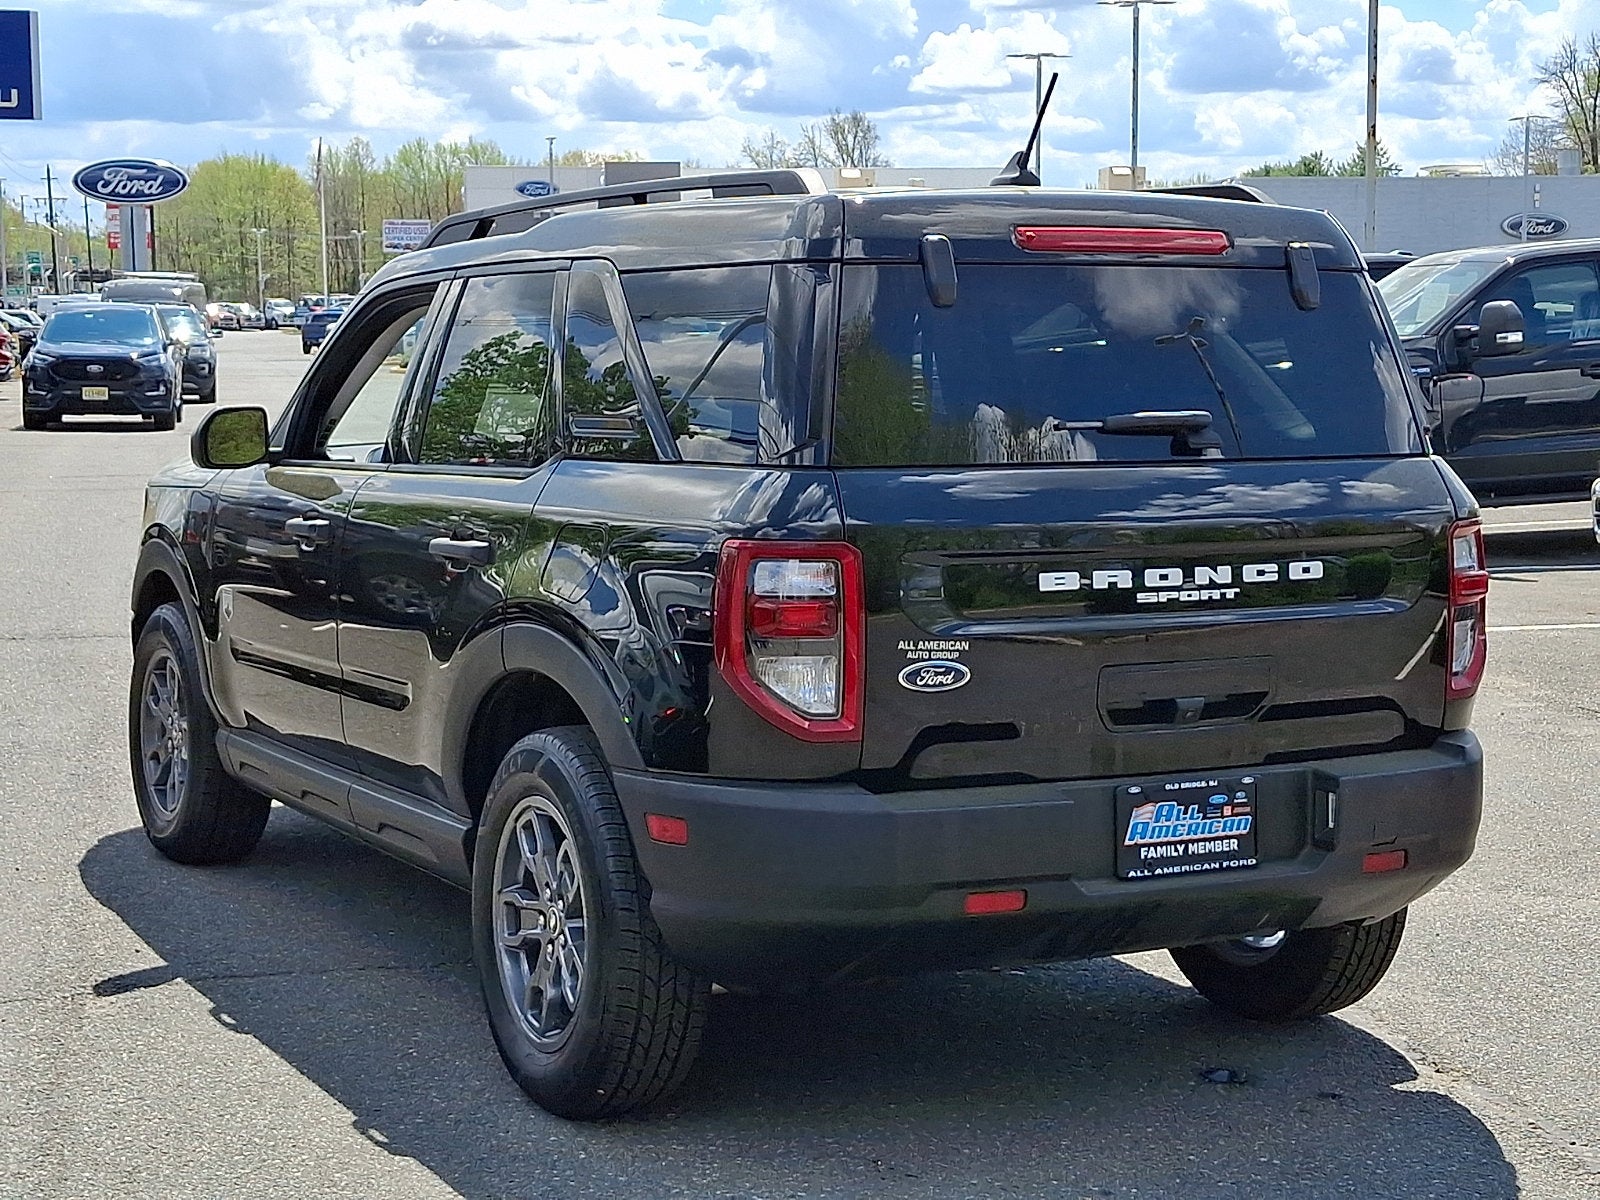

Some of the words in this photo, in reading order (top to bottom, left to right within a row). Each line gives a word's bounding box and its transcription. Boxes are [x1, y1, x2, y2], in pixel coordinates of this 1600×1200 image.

[97, 167, 164, 194] Ford
[524, 183, 549, 195] Ford
[385, 227, 412, 235] CERTIFIED
[413, 227, 429, 235] USED
[1038, 560, 1324, 592] BRONCO
[1136, 588, 1241, 603] SPORT
[898, 640, 916, 650] ALL
[917, 640, 970, 651] AMERICAN
[906, 650, 930, 659] AUTO
[930, 651, 960, 660] GROUP
[916, 667, 955, 686] Ford
[1140, 843, 1186, 859] FAMILY
[1188, 839, 1239, 855] MEMBER
[1128, 869, 1153, 878] ALL
[1153, 862, 1220, 875] AMERICAN
[1222, 858, 1257, 868] FORD
